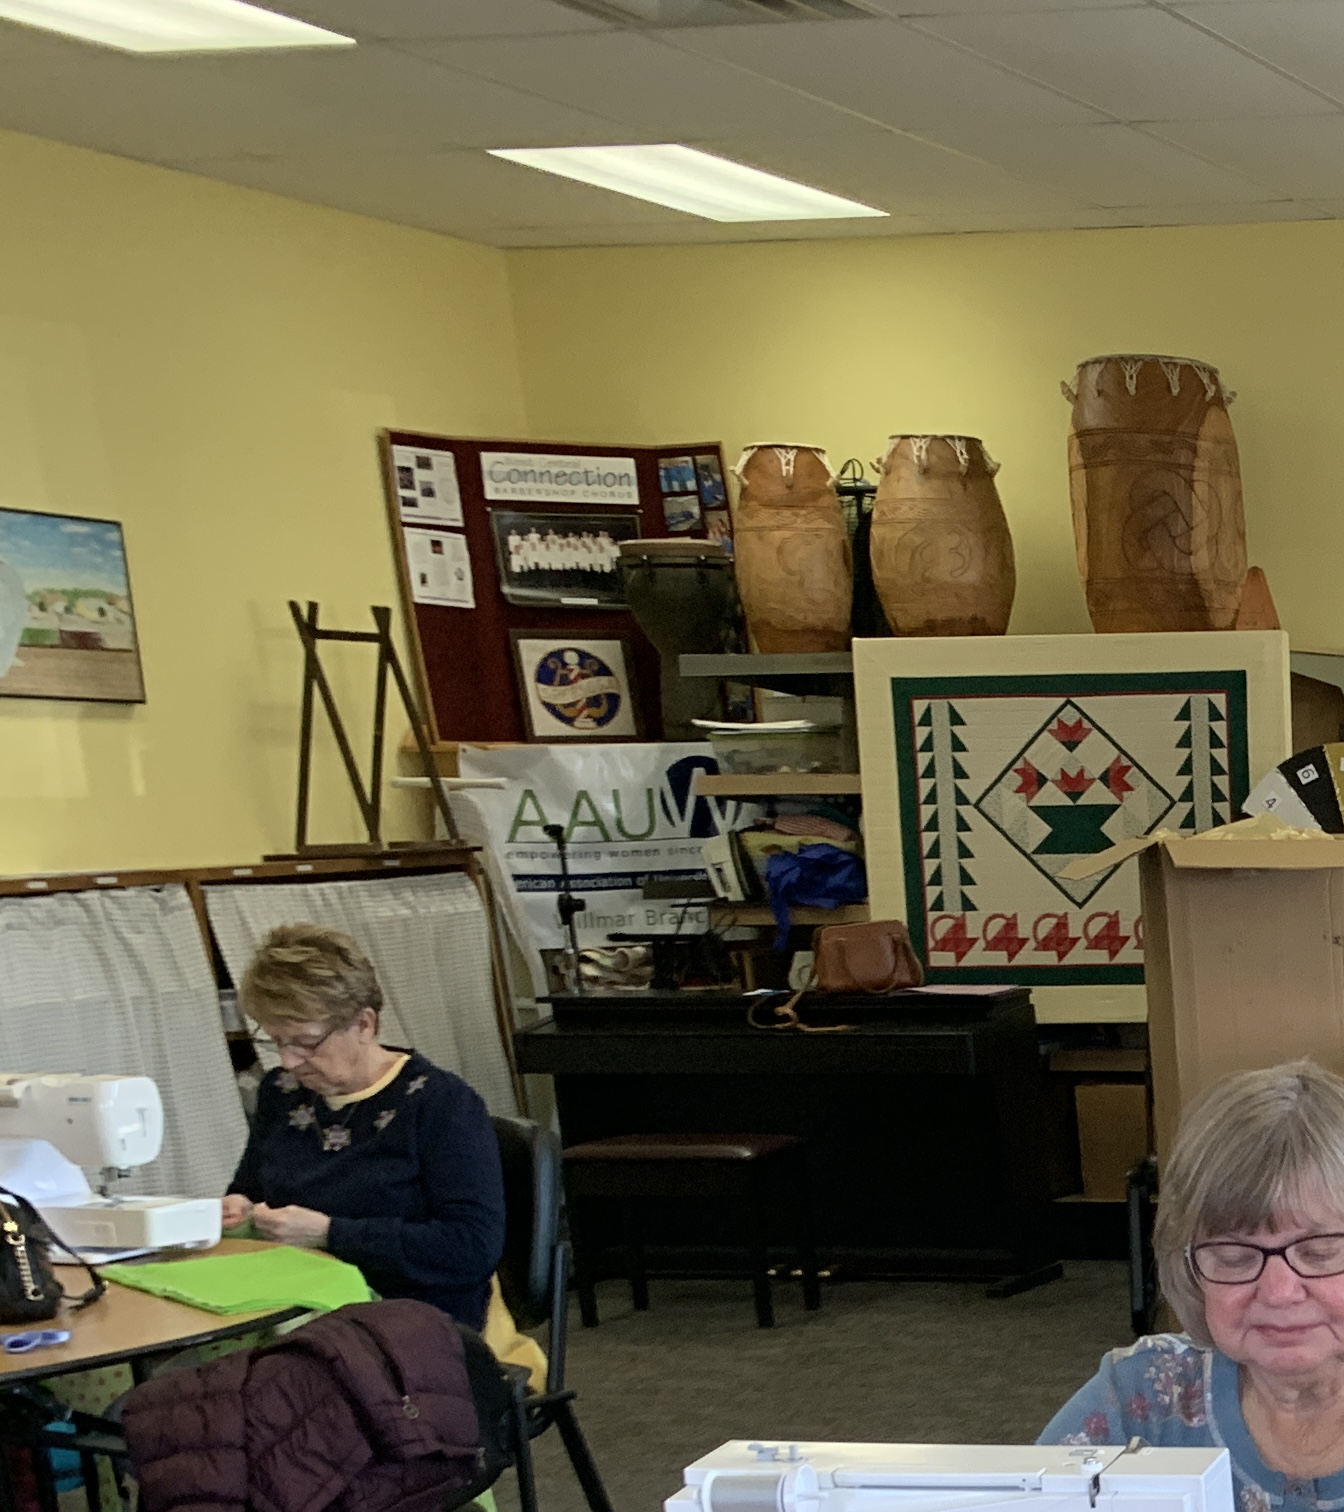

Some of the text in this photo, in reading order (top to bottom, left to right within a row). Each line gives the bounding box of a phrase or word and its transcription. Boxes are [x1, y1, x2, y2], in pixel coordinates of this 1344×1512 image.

[488, 461, 632, 488] Connection
[493, 487, 634, 500] BARBERSHOP CHORUS
[1301, 768, 1315, 779] 6
[1265, 797, 1277, 809] 4
[610, 848, 661, 859] women
